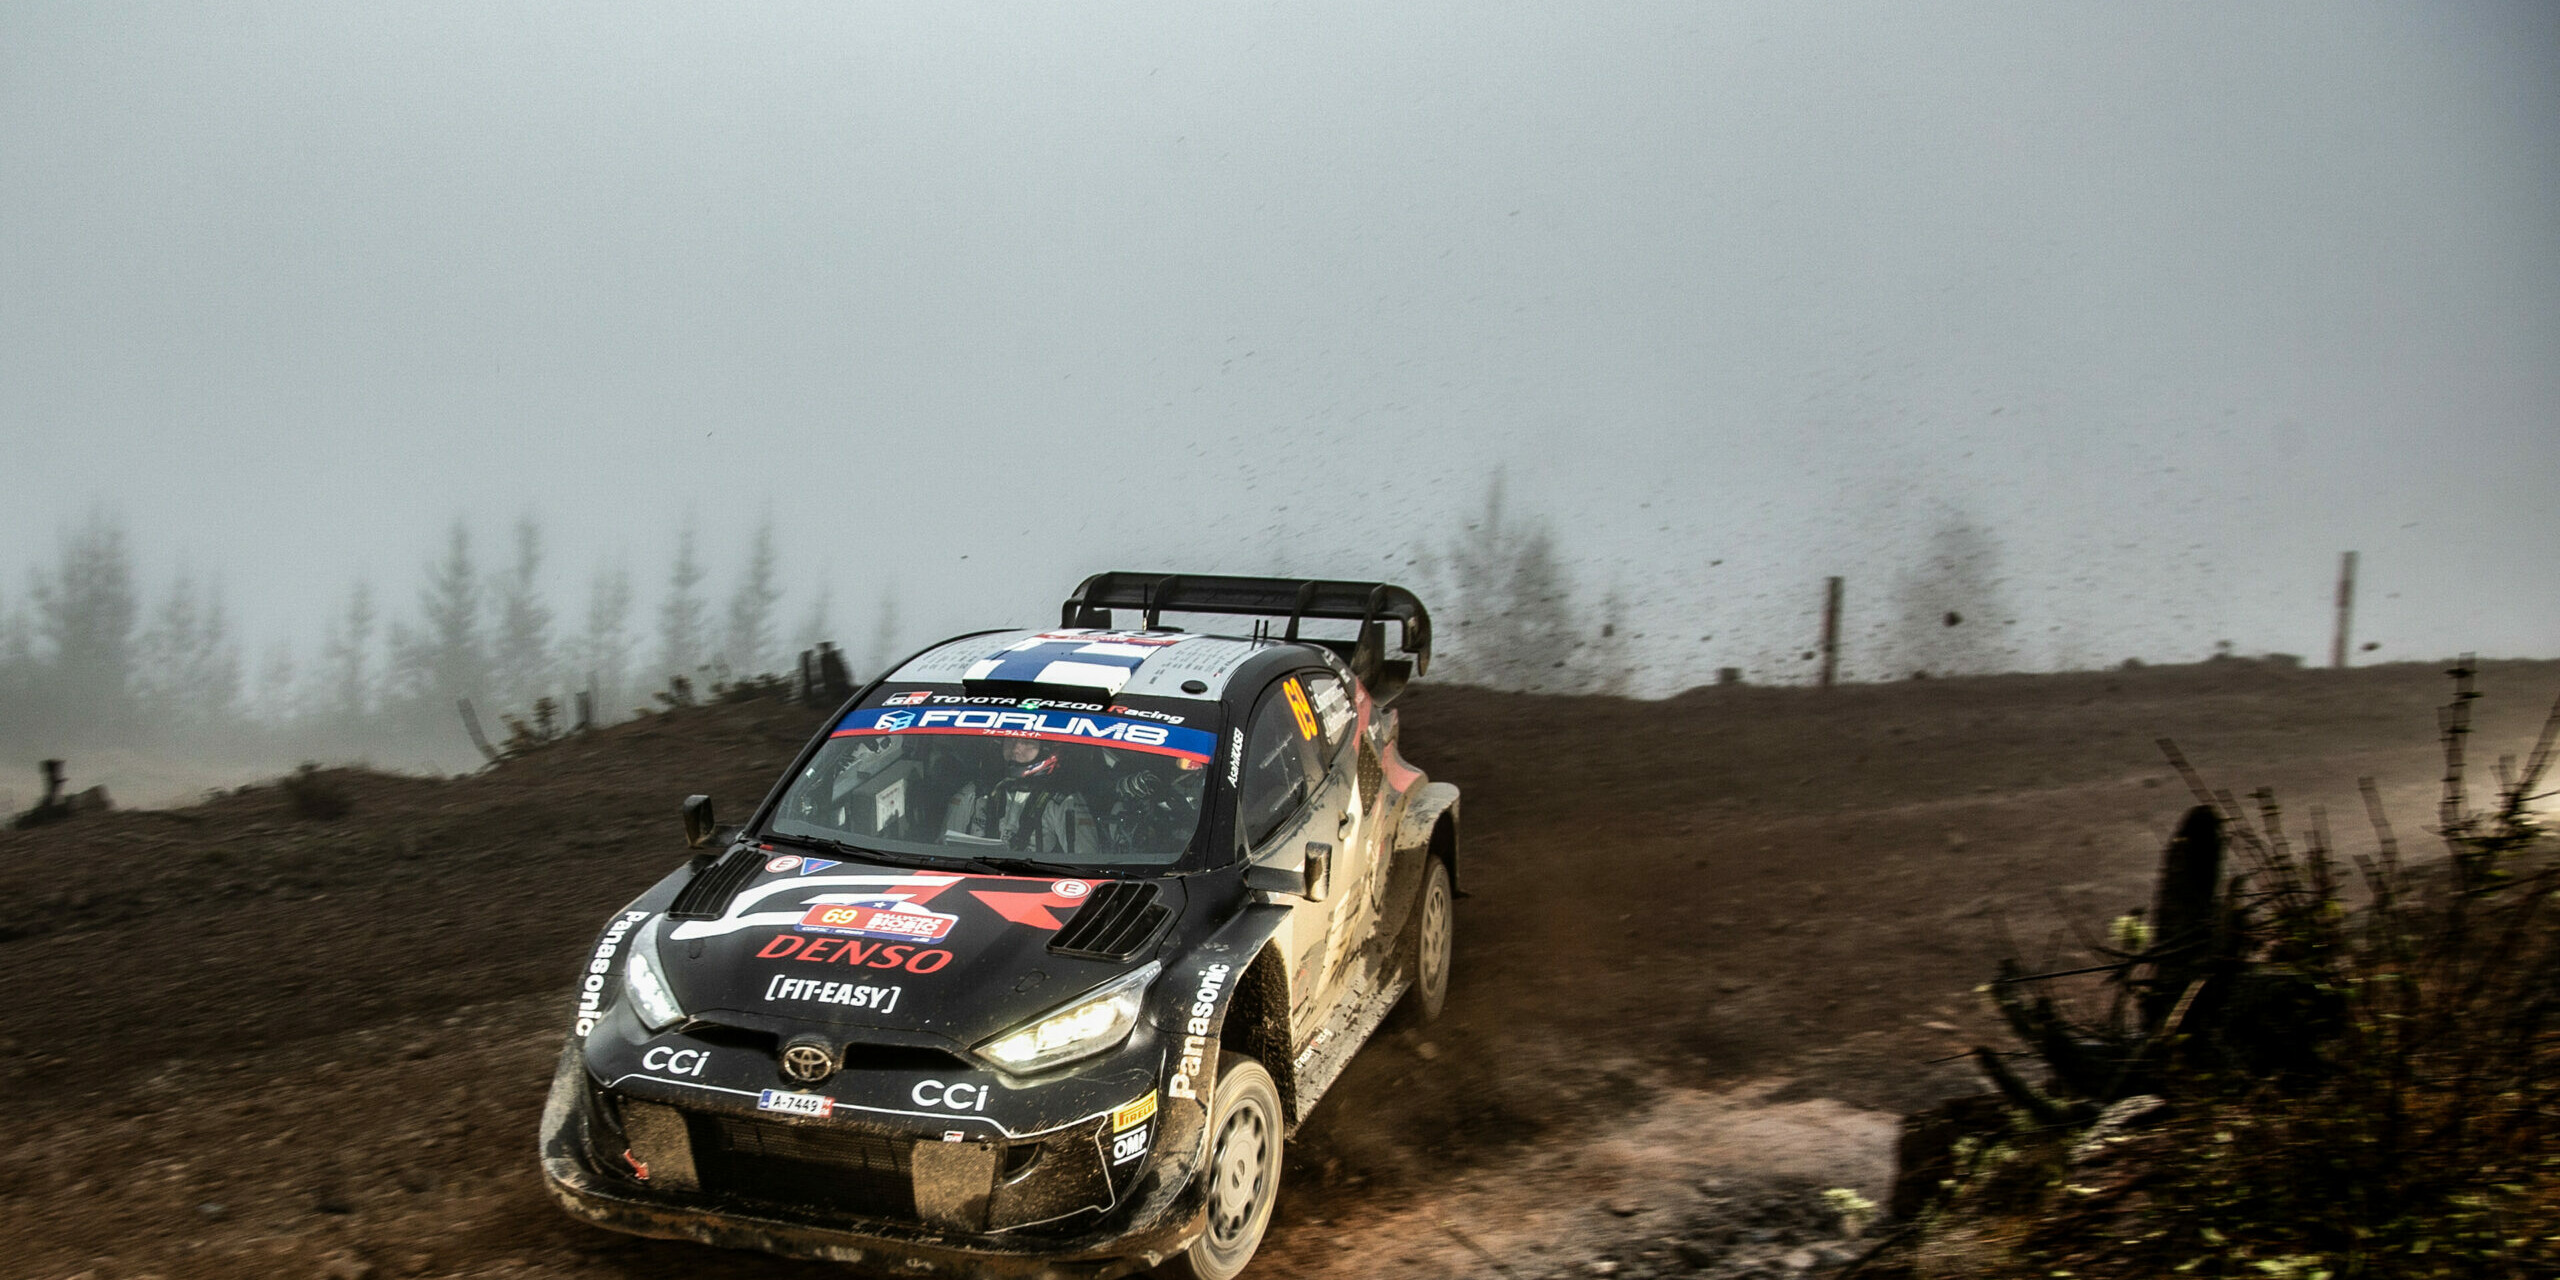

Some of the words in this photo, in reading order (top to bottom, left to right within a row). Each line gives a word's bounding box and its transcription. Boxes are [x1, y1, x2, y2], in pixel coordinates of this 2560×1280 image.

[932, 695, 1016, 705] TOYOTA
[1107, 705, 1185, 724] Racing
[1283, 677, 1318, 741] 69
[918, 710, 1169, 746] FORUM8
[821, 908, 858, 925] 69
[756, 934, 953, 974] DENSO
[575, 911, 650, 1037] Panasonic
[1168, 963, 1230, 1100] Panasonic
[772, 1095, 818, 1112] A-7449
[1119, 1096, 1155, 1126] PIRELLI
[1113, 1129, 1147, 1160] OMP
